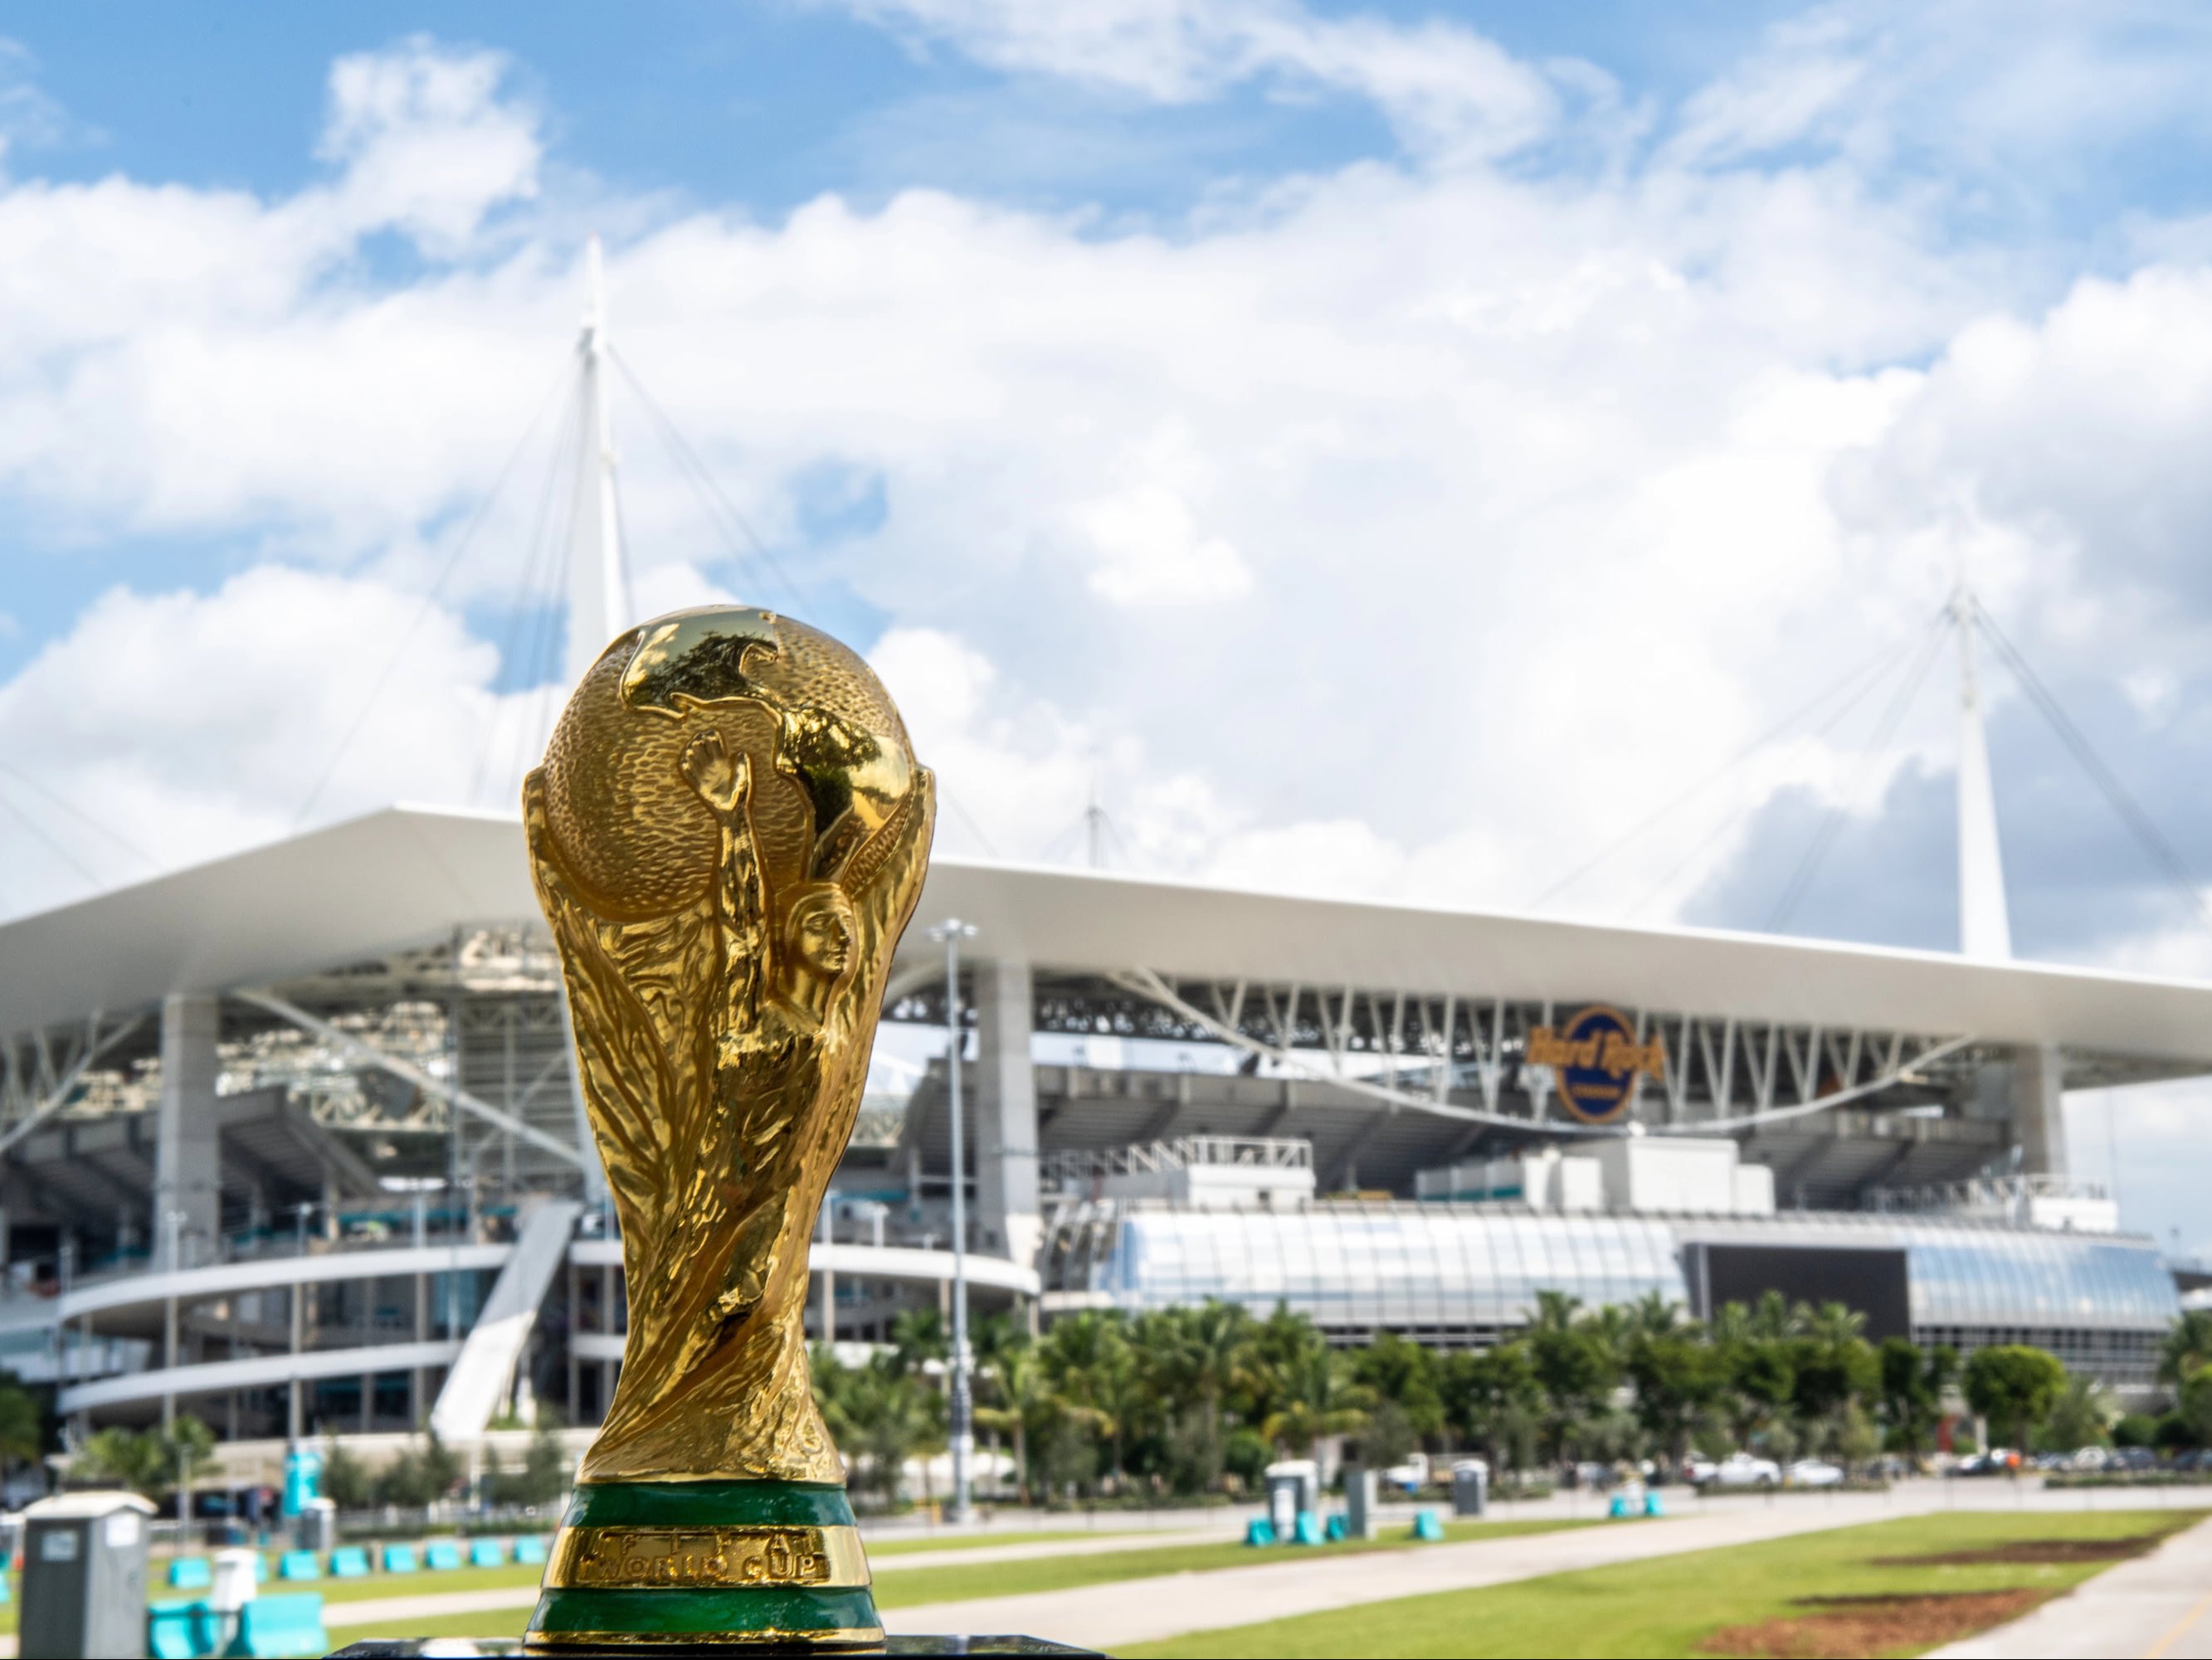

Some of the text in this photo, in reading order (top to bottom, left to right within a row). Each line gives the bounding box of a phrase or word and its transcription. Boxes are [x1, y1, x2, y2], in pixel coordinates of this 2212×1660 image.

[620, 1531, 791, 1555] FIFA
[594, 1553, 816, 1580] WORLD CUP
